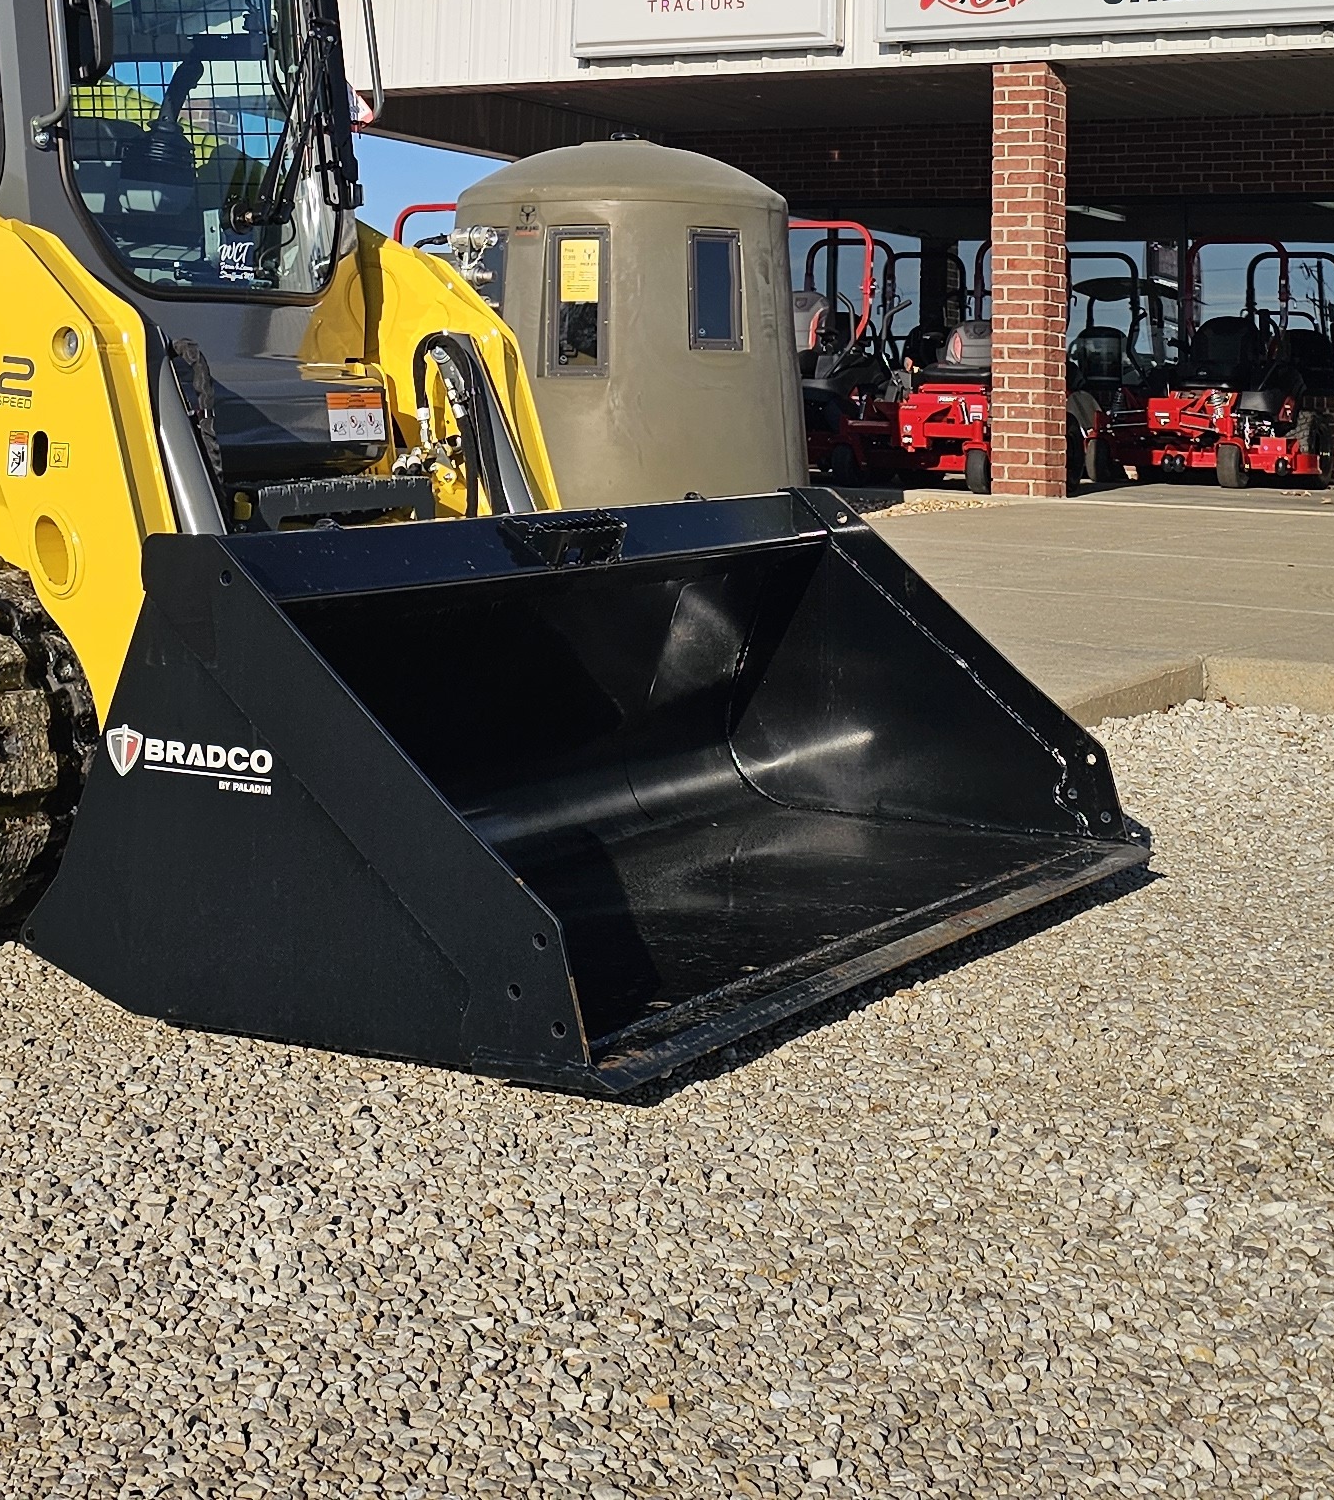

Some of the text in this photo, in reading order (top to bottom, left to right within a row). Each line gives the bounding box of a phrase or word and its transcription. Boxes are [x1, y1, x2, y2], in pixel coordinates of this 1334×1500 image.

[217, 242, 254, 263] WCT
[144, 738, 273, 774] BRADCO
[218, 781, 272, 795] BY PALADIN
